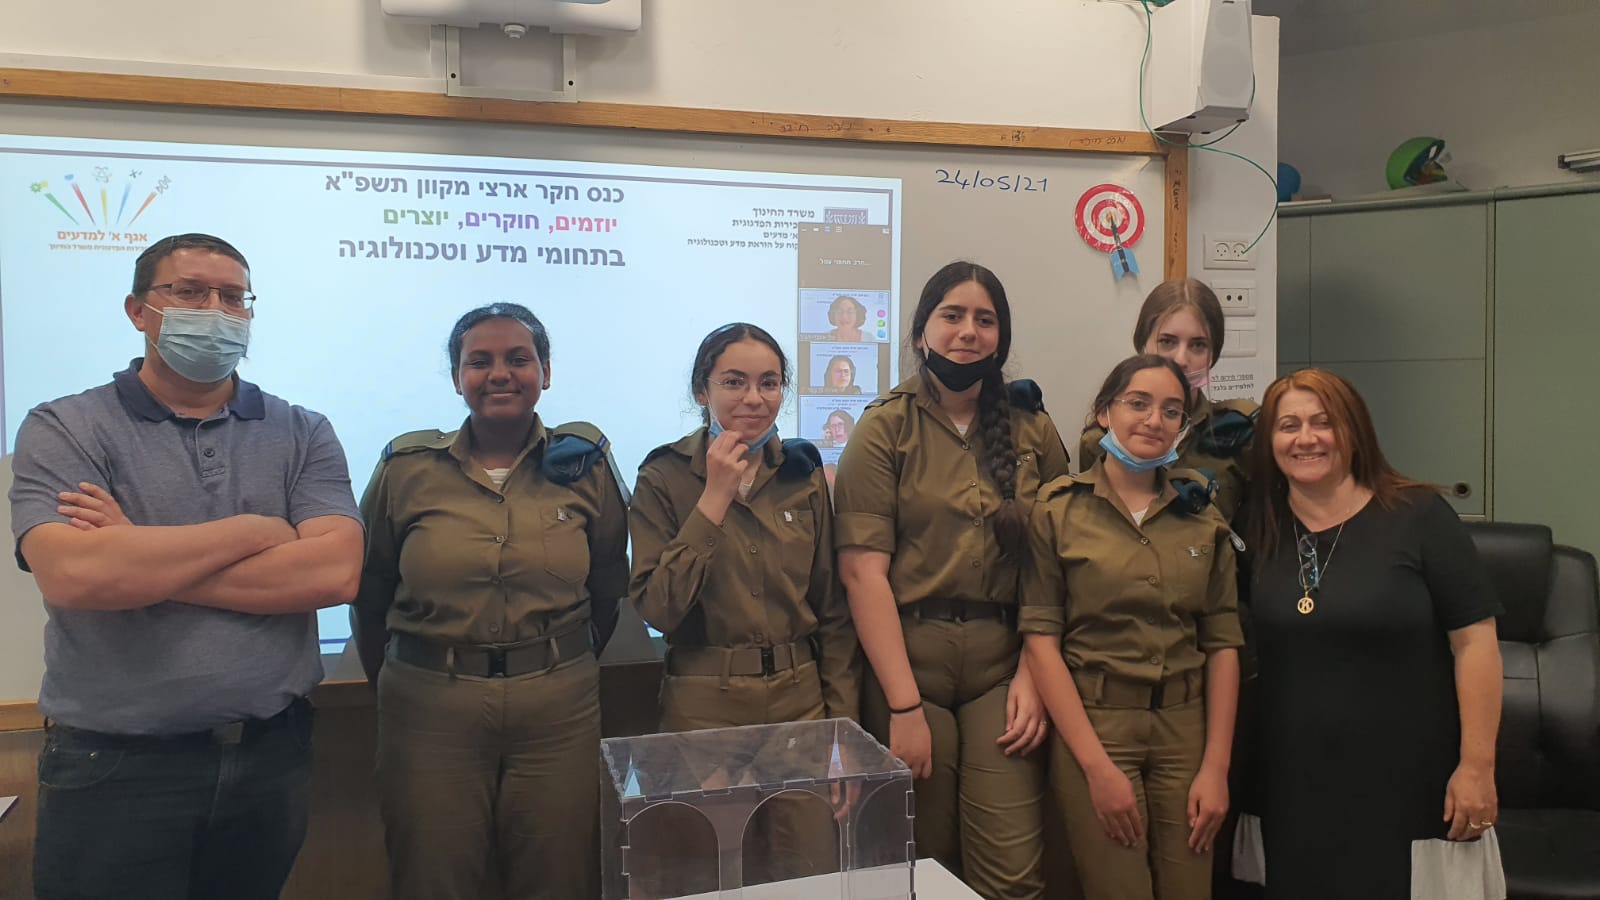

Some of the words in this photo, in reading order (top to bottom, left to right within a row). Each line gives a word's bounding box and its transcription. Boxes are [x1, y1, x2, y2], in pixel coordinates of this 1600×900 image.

[325, 171, 408, 194] תשפ"א
[416, 178, 470, 200] מקוון
[478, 181, 528, 199] ארצי
[935, 169, 1048, 193] 24/05/21
[535, 183, 579, 205] חקר
[586, 186, 625, 204] כנס
[383, 207, 450, 226] יוצרים
[457, 209, 541, 233] חוקרים,
[752, 207, 785, 219] החינוך
[788, 208, 816, 219] משרד
[548, 215, 618, 235] יוזמים,
[731, 218, 773, 230] הפדגוגית
[773, 220, 799, 230] כירות
[57, 230, 105, 241] למדעים
[125, 233, 148, 244] אגף
[687, 238, 729, 249] וטכנולוגיה
[729, 239, 747, 249] מדע
[763, 231, 789, 240] מדעים
[774, 239, 785, 250] על
[338, 236, 468, 261] וטכנולוגיה
[475, 243, 528, 265] מדע
[747, 240, 774, 250] הוראת
[537, 245, 627, 267] בתחומי
